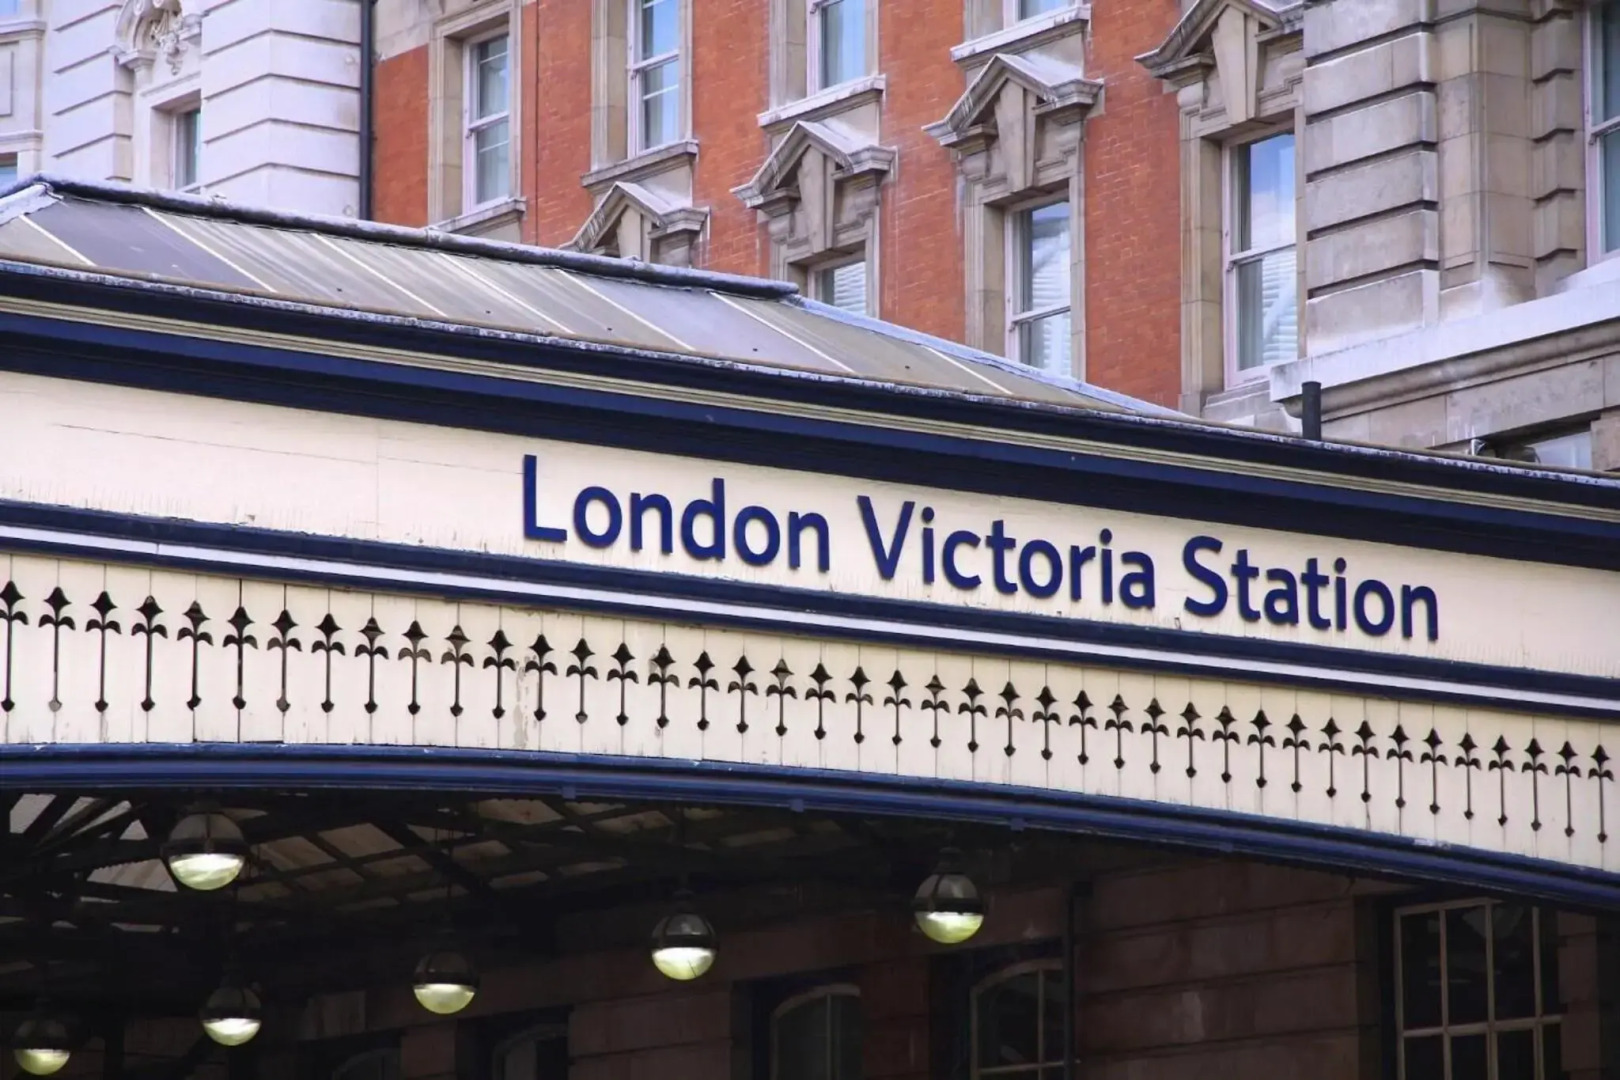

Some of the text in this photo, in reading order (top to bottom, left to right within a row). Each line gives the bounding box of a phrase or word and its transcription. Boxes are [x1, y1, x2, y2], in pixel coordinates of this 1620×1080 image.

[522, 454, 1439, 643] London Victoria Station
